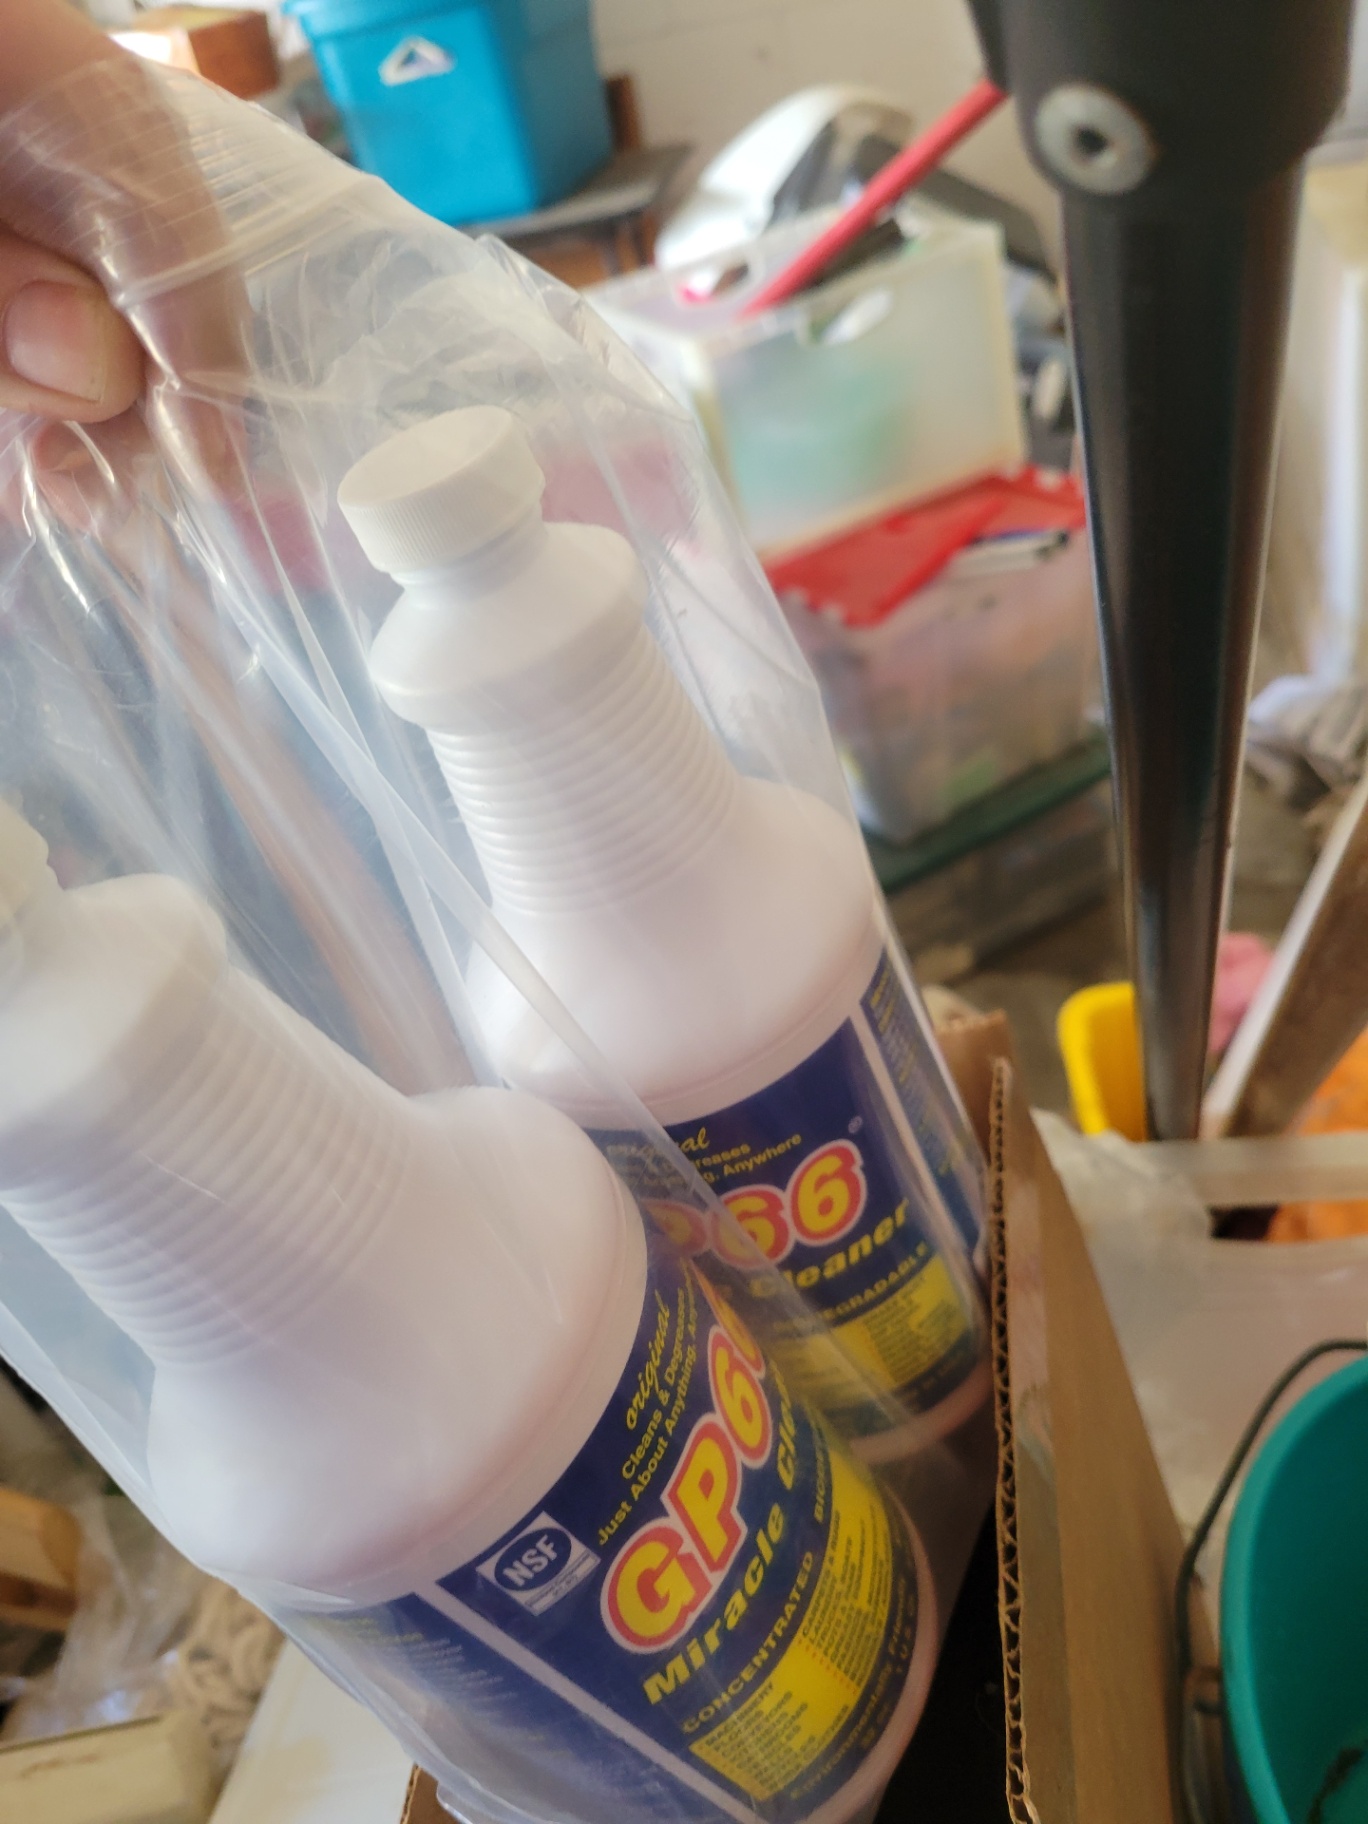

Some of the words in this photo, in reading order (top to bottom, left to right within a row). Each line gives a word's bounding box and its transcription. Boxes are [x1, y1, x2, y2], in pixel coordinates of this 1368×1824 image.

[723, 1133, 803, 1177] Anywhere
[626, 1288, 670, 1430] original
[621, 1408, 663, 1480] Cleans
[657, 1388, 671, 1407] &
[598, 1500, 633, 1546] Just
[630, 1435, 669, 1501] About
[502, 1533, 558, 1588] NSF
[642, 1501, 785, 1706] Miracle
[682, 1551, 813, 1735] CONCENTRATED
